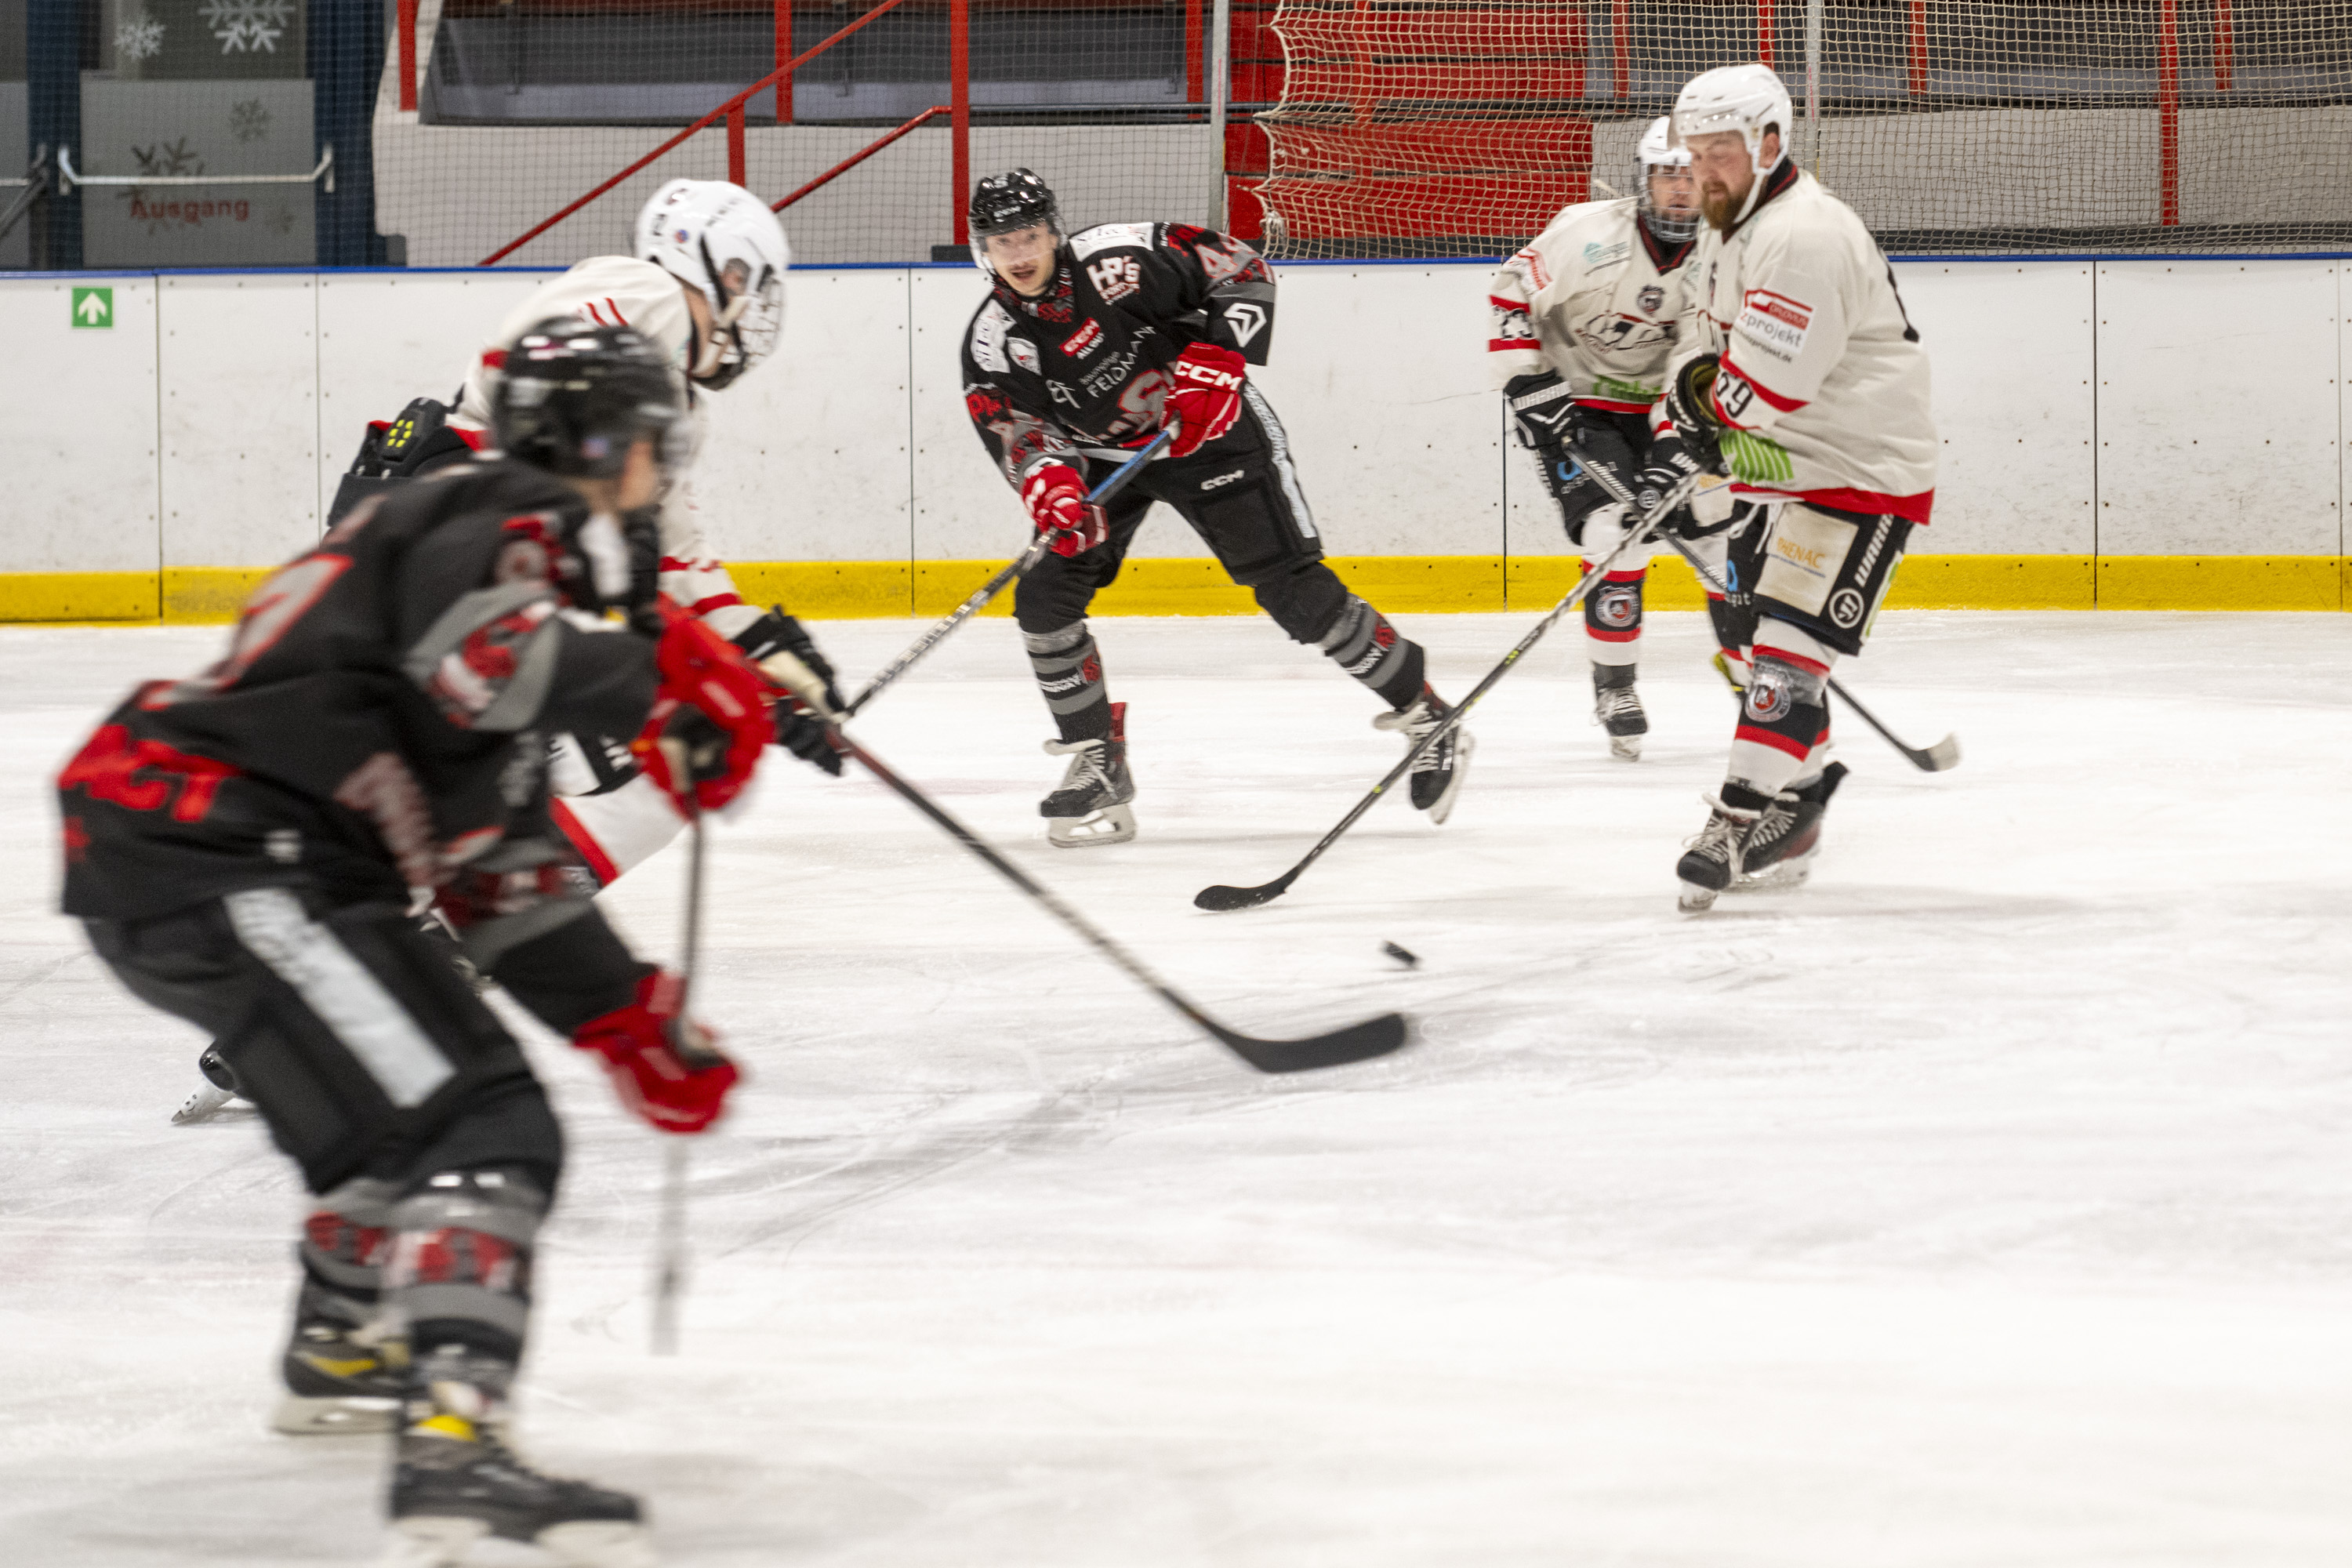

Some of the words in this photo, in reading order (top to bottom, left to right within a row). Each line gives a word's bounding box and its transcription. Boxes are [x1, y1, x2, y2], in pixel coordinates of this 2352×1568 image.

[130, 198, 249, 223] Ausgang
[1174, 360, 1243, 390] CCM
[1200, 469, 1245, 491] CCM
